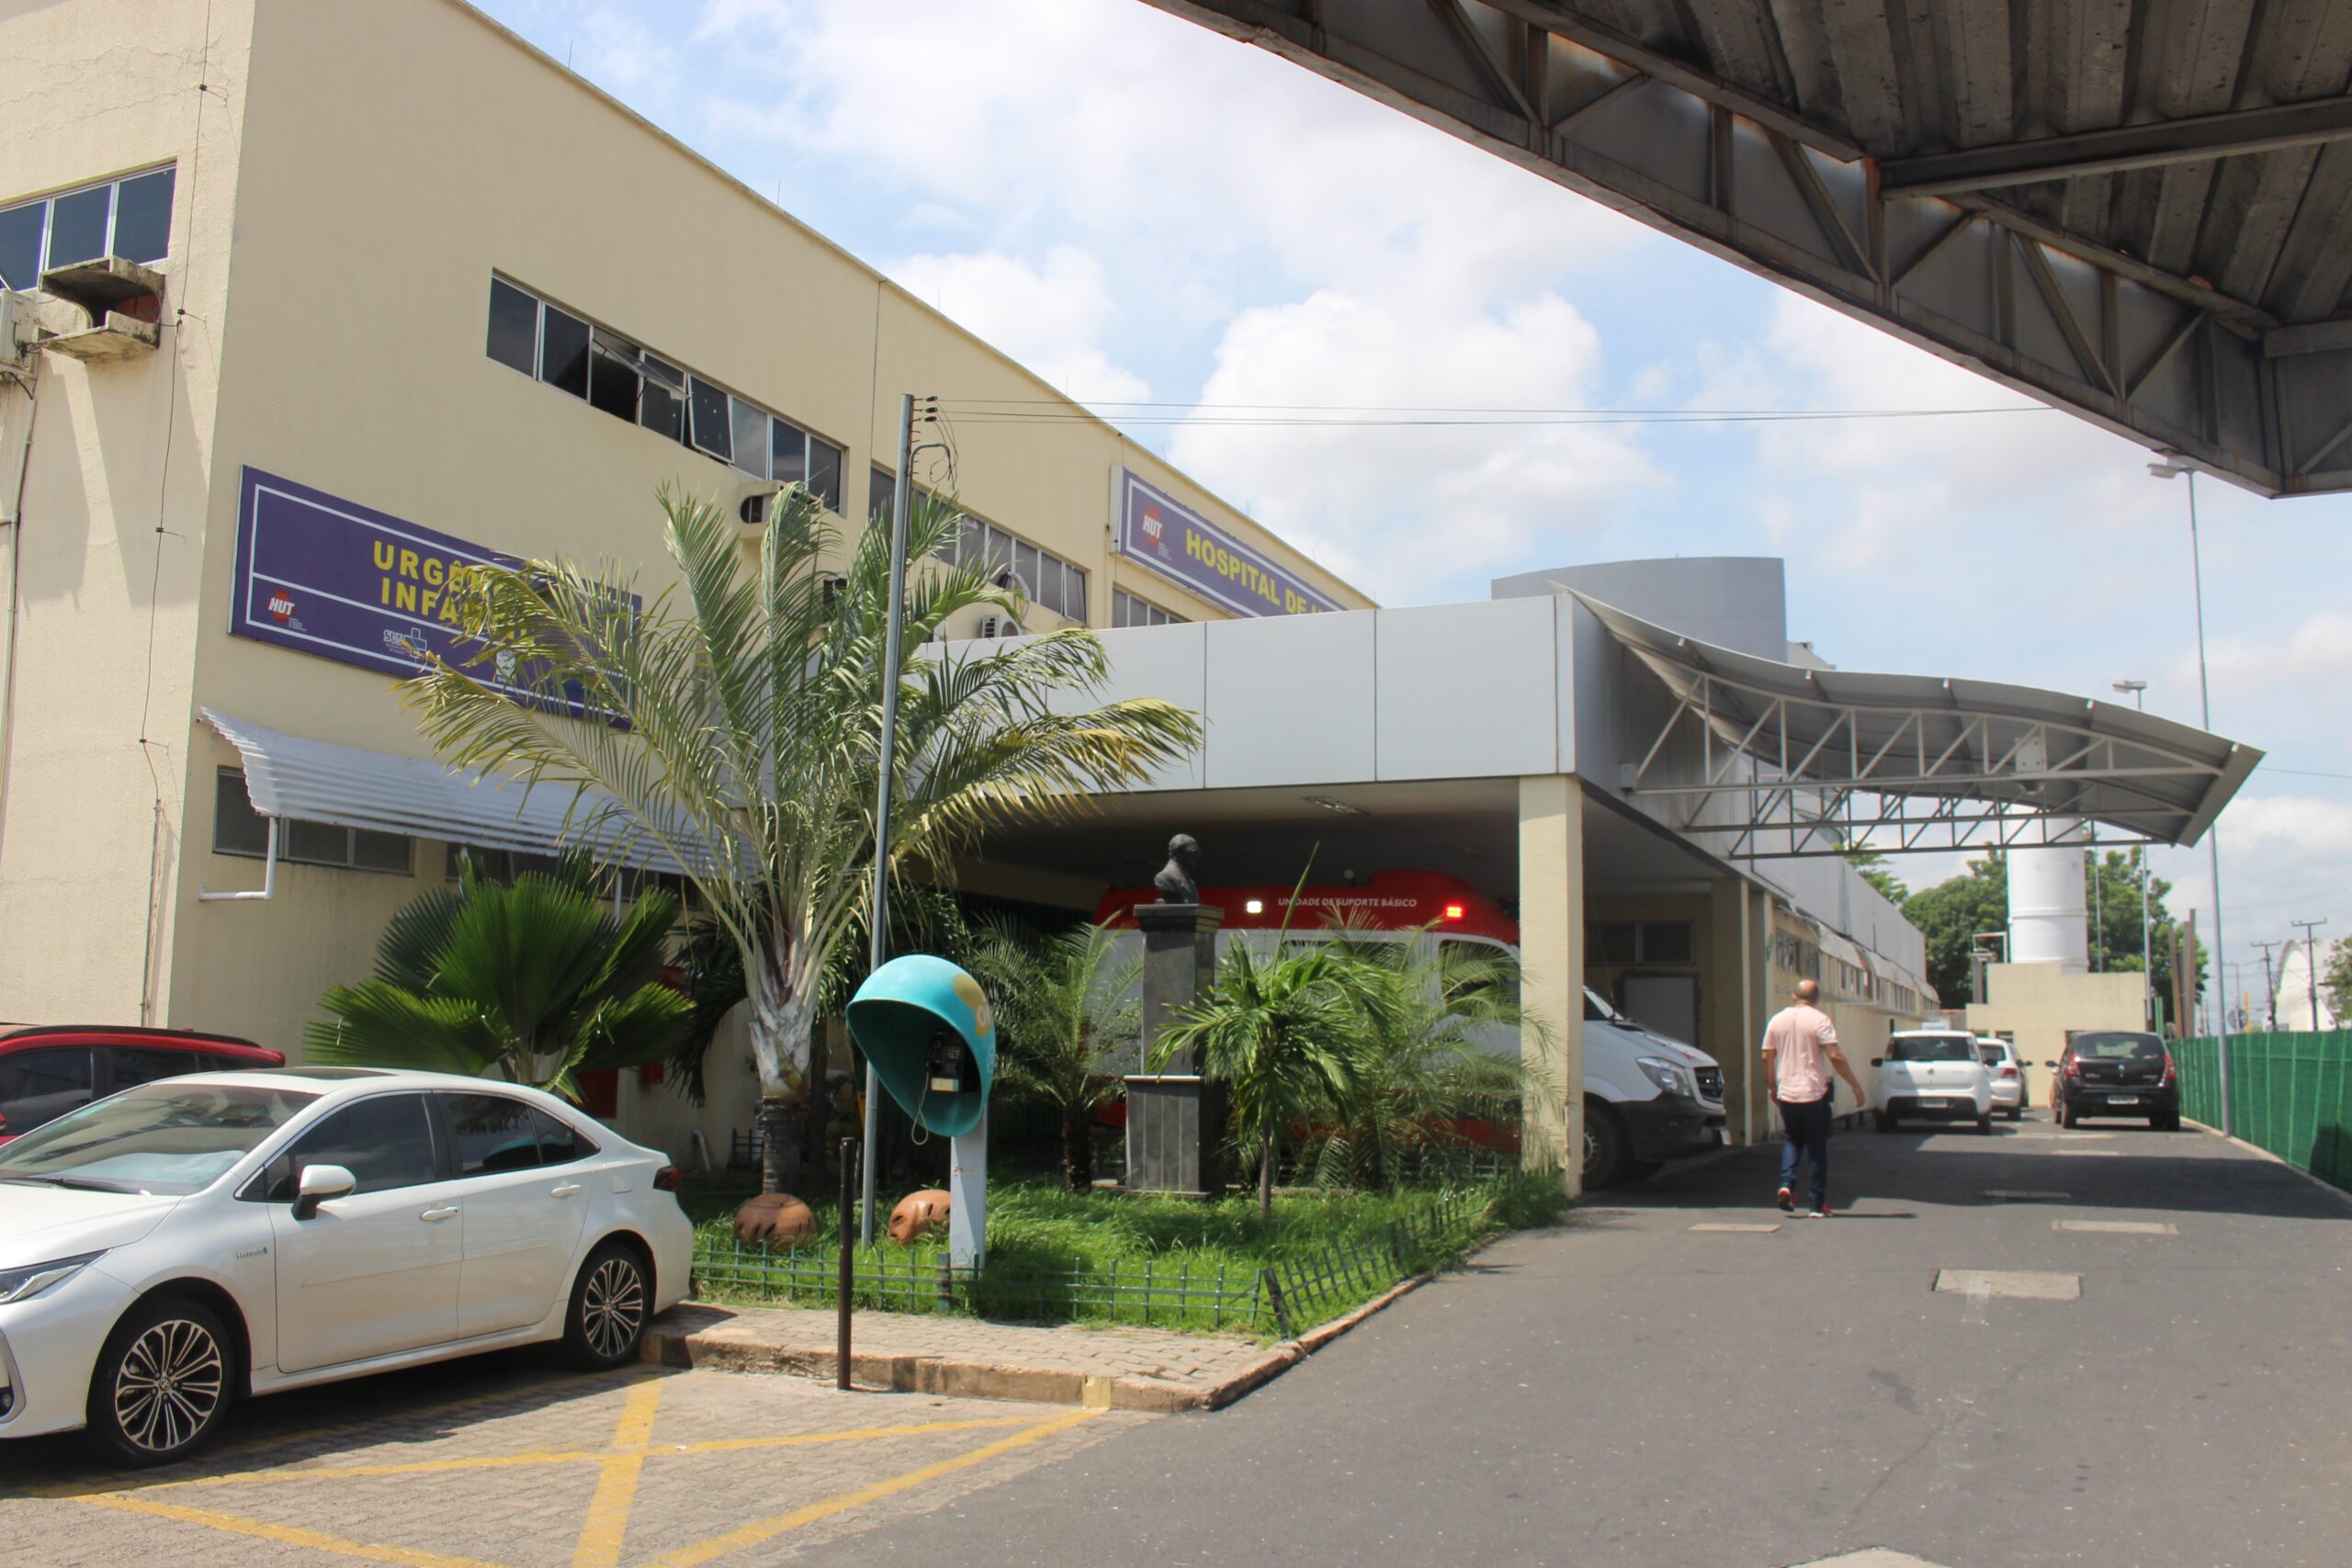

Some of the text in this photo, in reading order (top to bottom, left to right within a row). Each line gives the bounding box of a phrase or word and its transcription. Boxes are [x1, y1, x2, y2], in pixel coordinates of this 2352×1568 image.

[1142, 513, 1163, 539] HUT
[1185, 528, 1281, 606] HOSPITAL
[268, 597, 295, 616] HUT
[1278, 897, 1320, 907] UNDADE
[1336, 897, 1379, 907] SUPORTE
[1381, 897, 1418, 908] BÁSICO
